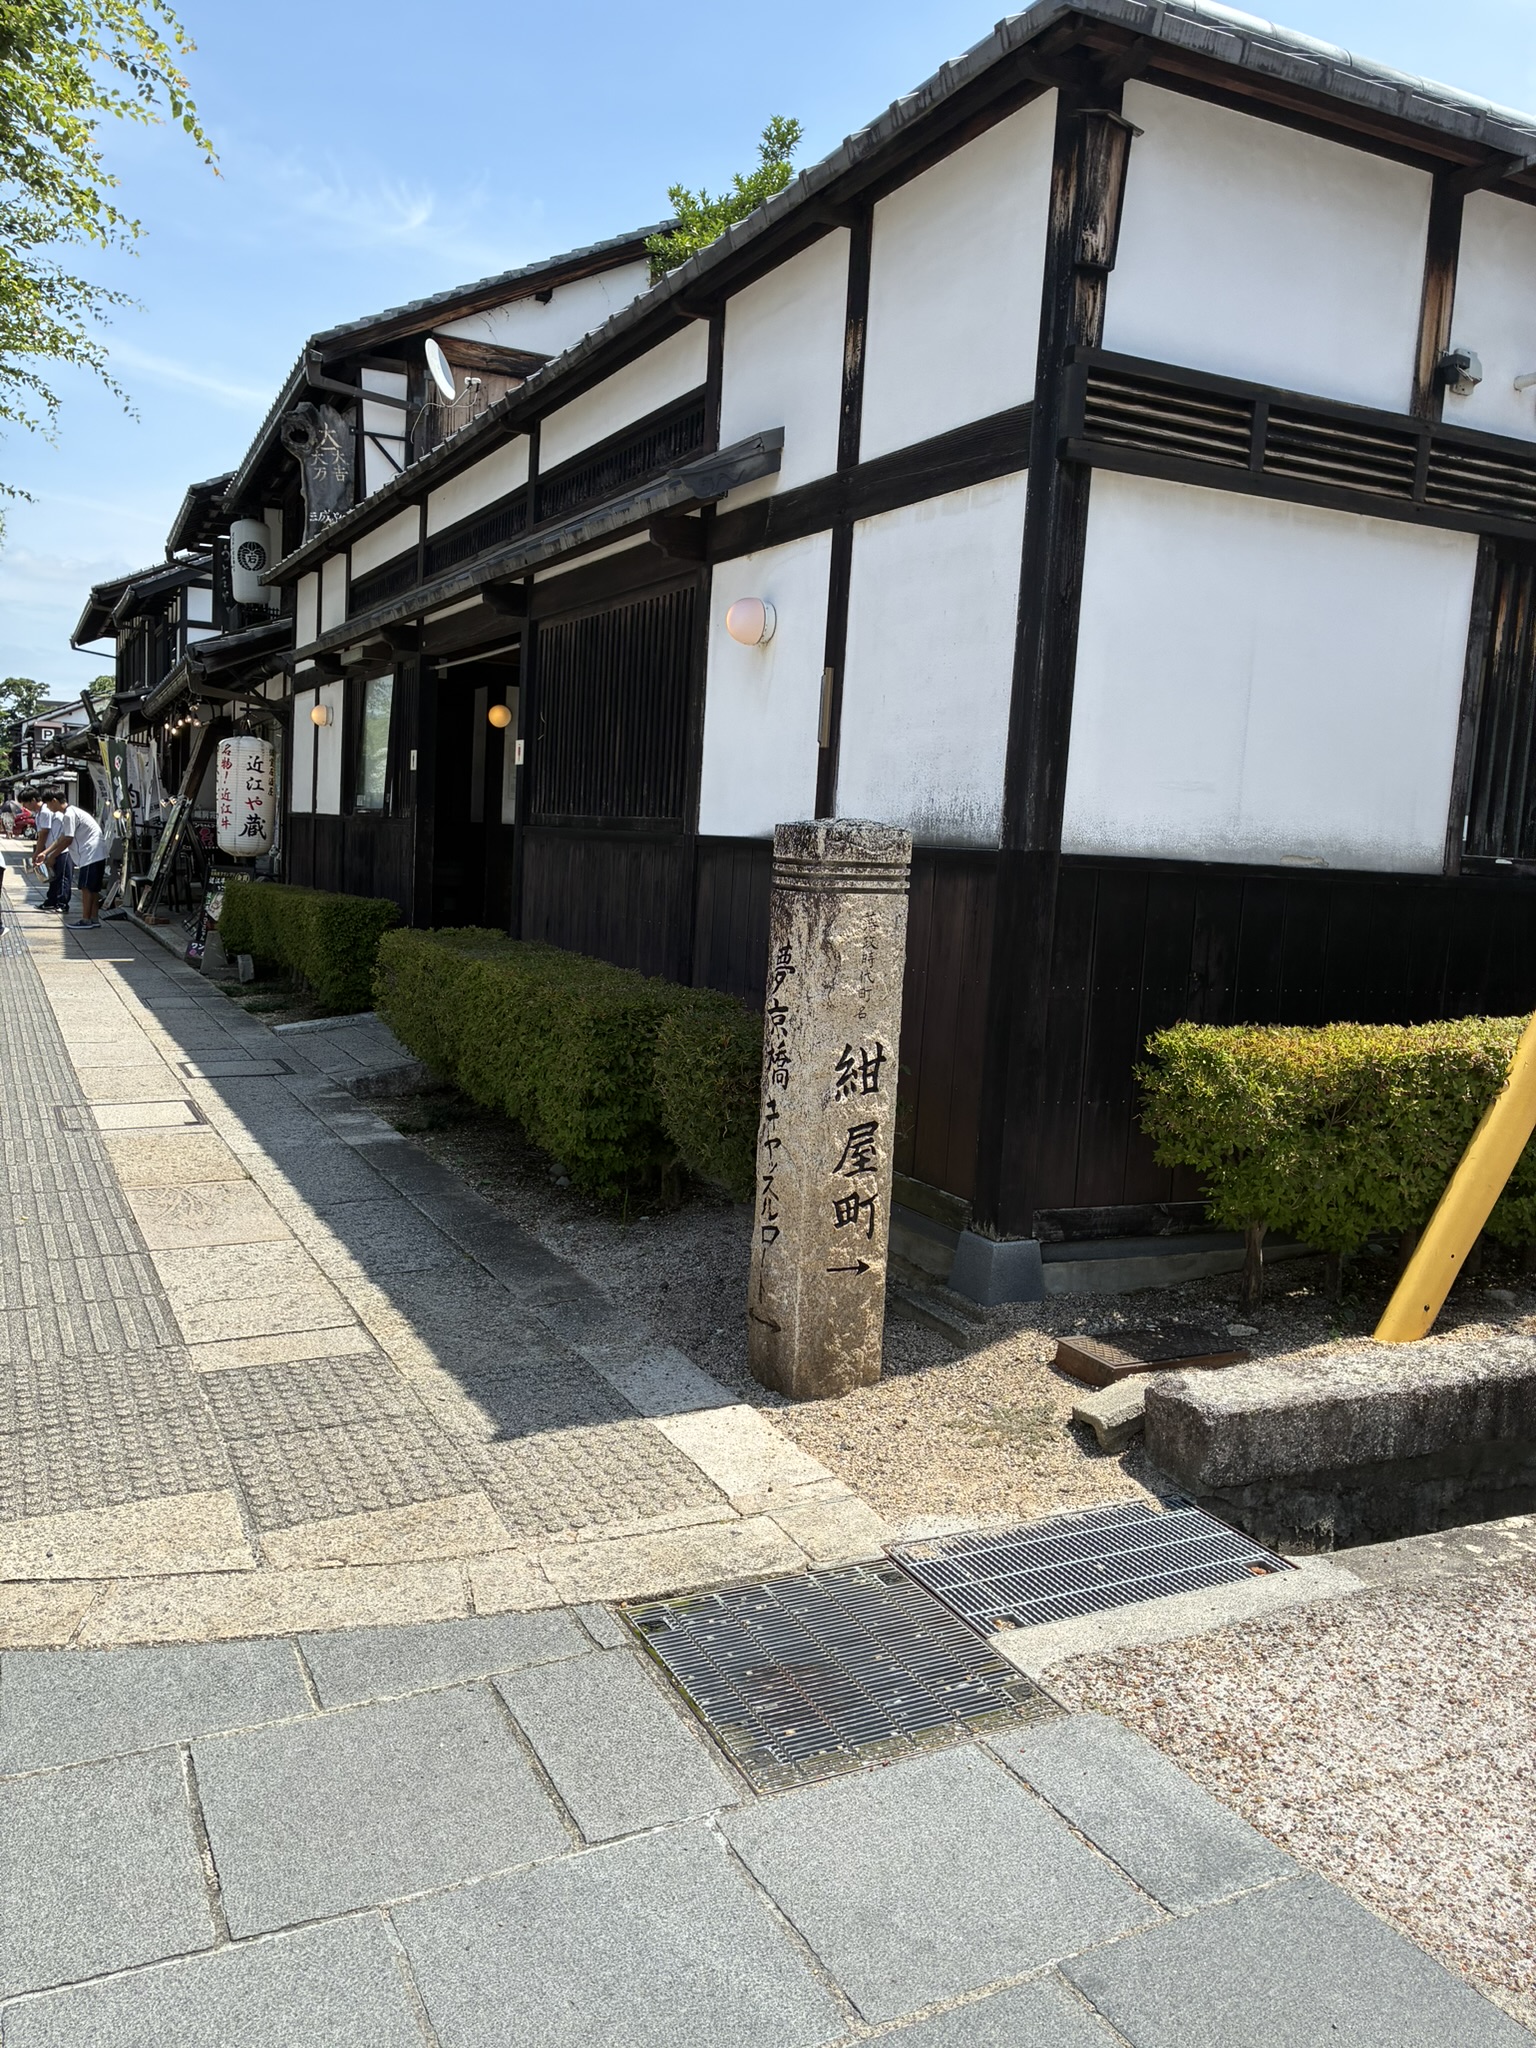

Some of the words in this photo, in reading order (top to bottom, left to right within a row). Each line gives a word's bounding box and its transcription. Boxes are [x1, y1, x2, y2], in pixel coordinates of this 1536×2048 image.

[43, 730, 53, 739] P
[238, 755, 267, 841] 近江や蔵
[832, 1041, 887, 1240] 紺屋町
